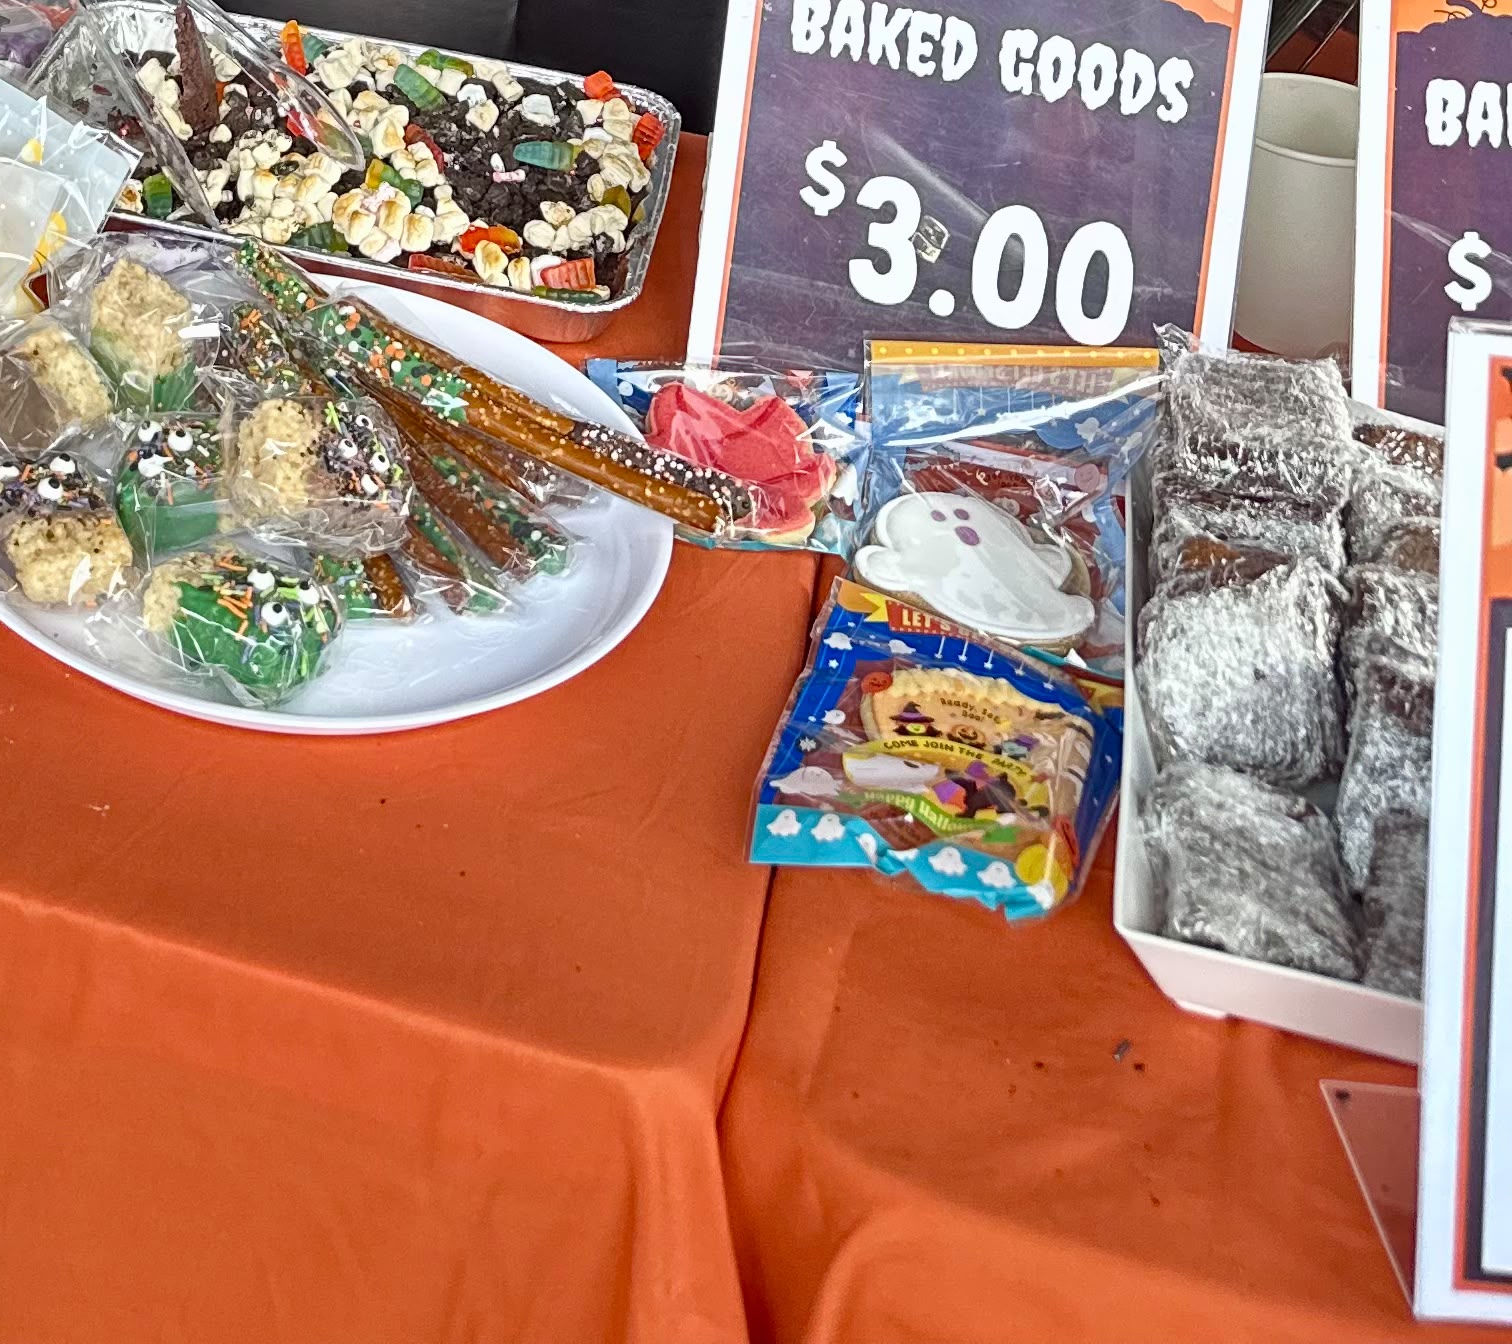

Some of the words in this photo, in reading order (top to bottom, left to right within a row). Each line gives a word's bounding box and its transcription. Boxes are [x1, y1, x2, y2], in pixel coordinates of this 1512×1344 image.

[999, 28, 1194, 123] GOODS
[799, 139, 1135, 346] $3.00
[884, 740, 918, 749] COME
[923, 740, 954, 752] JOIN
[958, 747, 984, 759] THE
